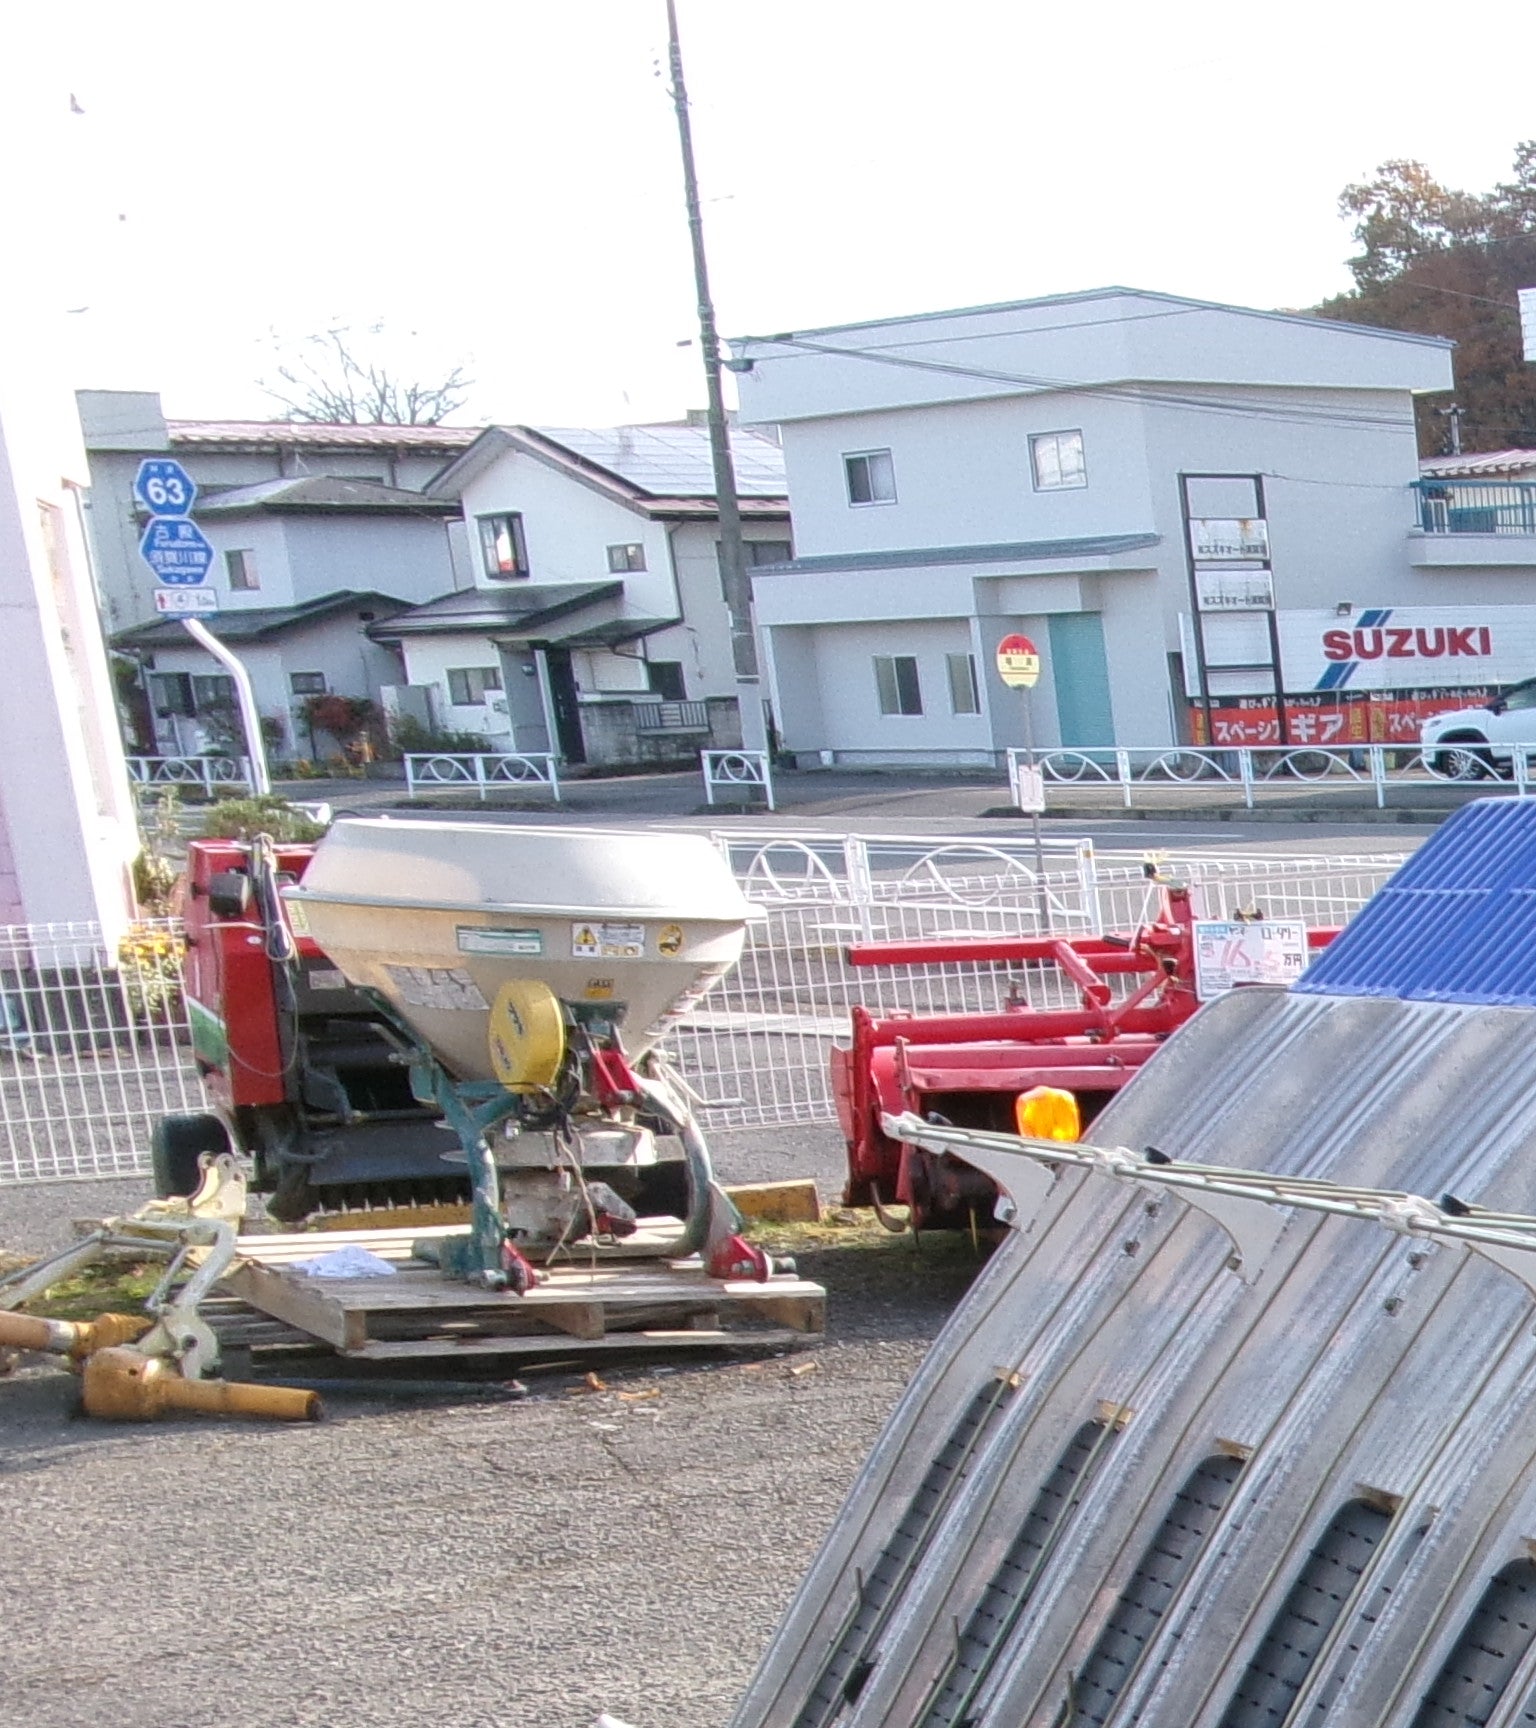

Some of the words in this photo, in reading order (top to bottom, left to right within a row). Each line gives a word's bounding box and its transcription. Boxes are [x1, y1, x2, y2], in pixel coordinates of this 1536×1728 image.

[147, 478, 185, 505] 63
[1322, 626, 1492, 661] SUZUKI
[1290, 713, 1344, 744] ギア
